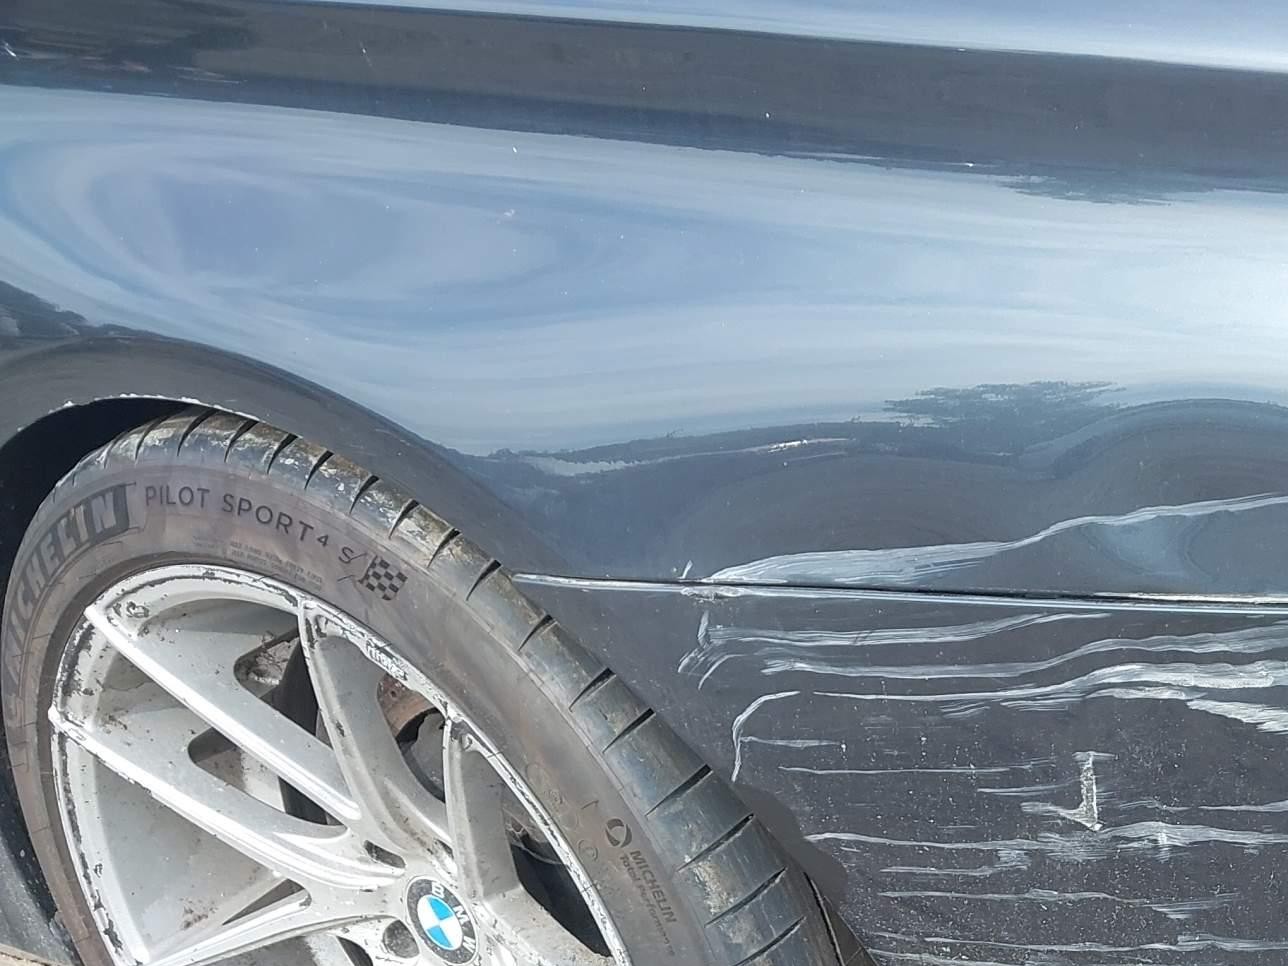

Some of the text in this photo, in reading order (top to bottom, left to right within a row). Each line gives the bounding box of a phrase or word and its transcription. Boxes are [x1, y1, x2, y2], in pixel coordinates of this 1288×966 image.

[144, 485, 210, 508] PILOT
[221, 493, 314, 542] SPORT
[316, 534, 330, 548] 4
[431, 881, 476, 954] BMW
[629, 850, 678, 924] MICHELIN
